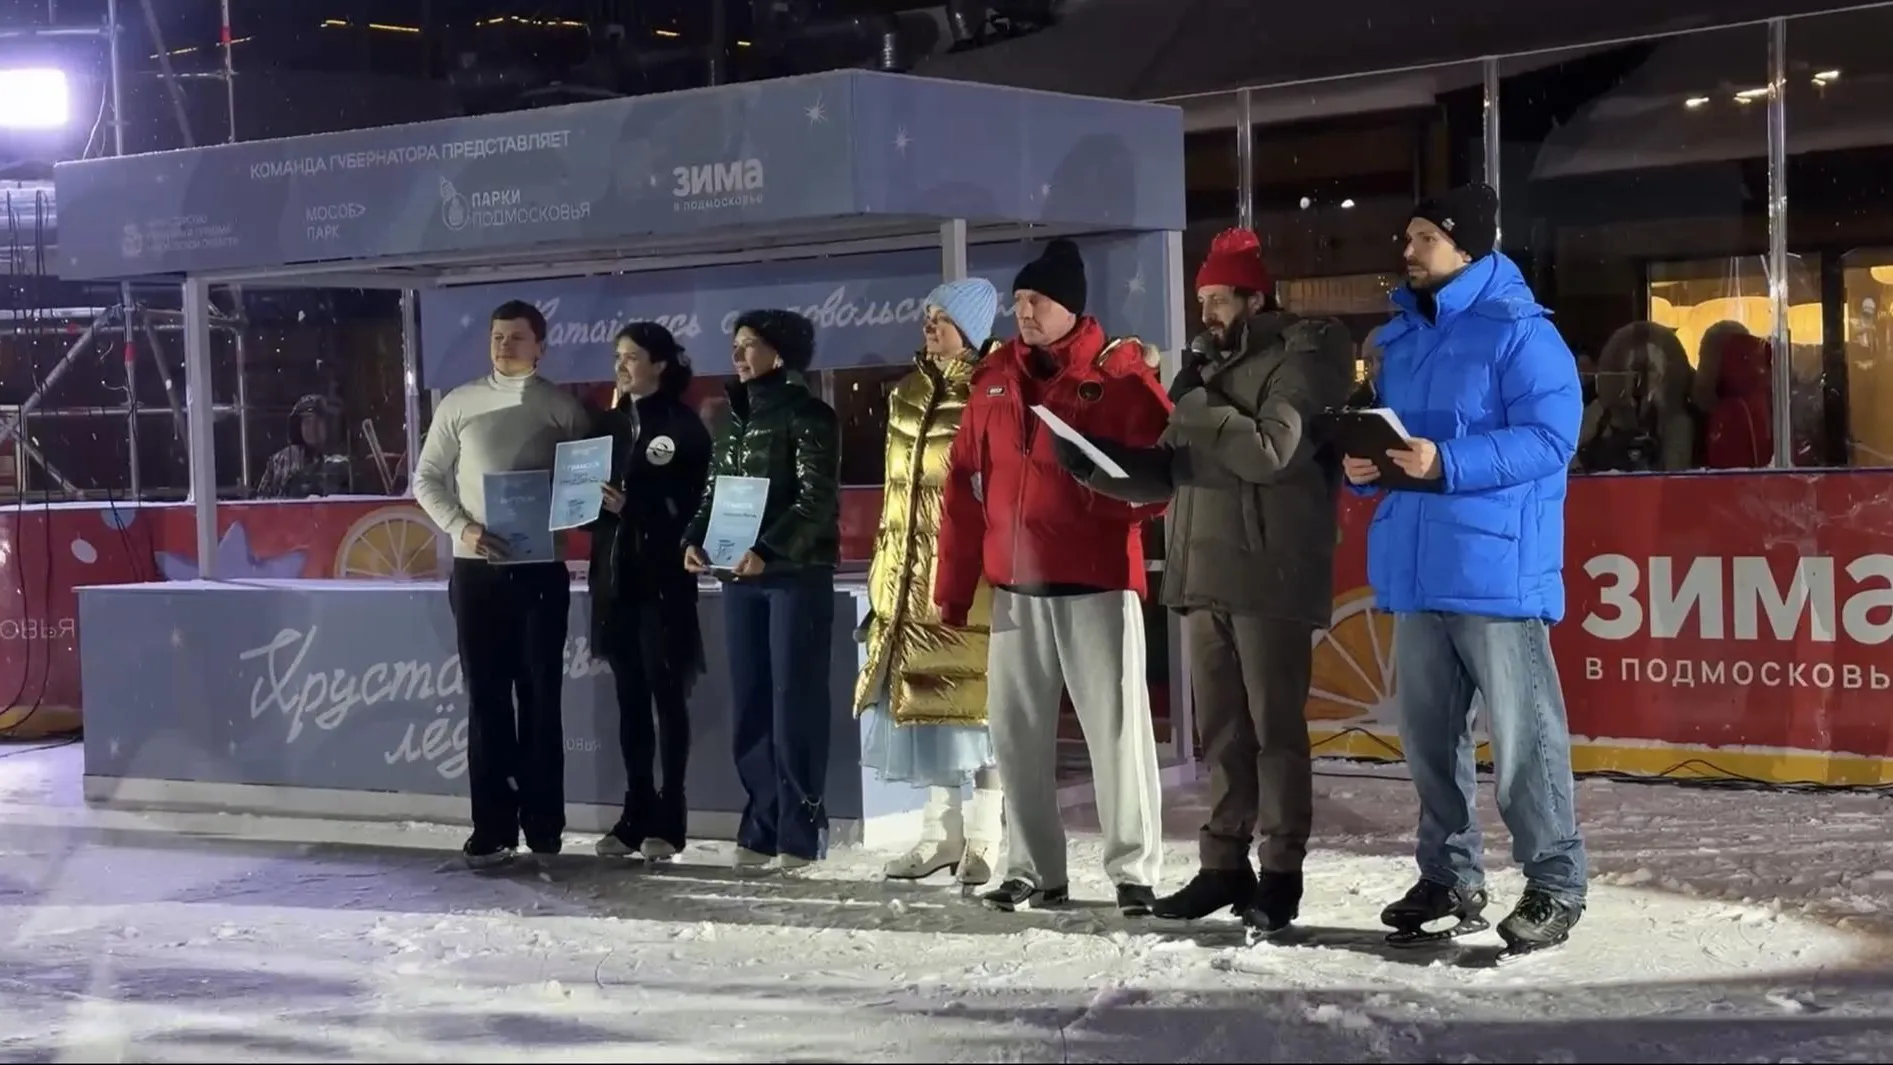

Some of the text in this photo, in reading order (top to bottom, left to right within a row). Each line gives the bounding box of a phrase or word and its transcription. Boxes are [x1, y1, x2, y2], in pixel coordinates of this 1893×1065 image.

[250, 130, 571, 179] КОМАНДА ГУБЕРНАТОРА ПРЕДСТАВЛЯЕТ
[471, 189, 521, 208] ПАРКИ
[471, 202, 591, 226] ПОДМОСКОВЬЯ
[306, 224, 340, 242] ПАРК
